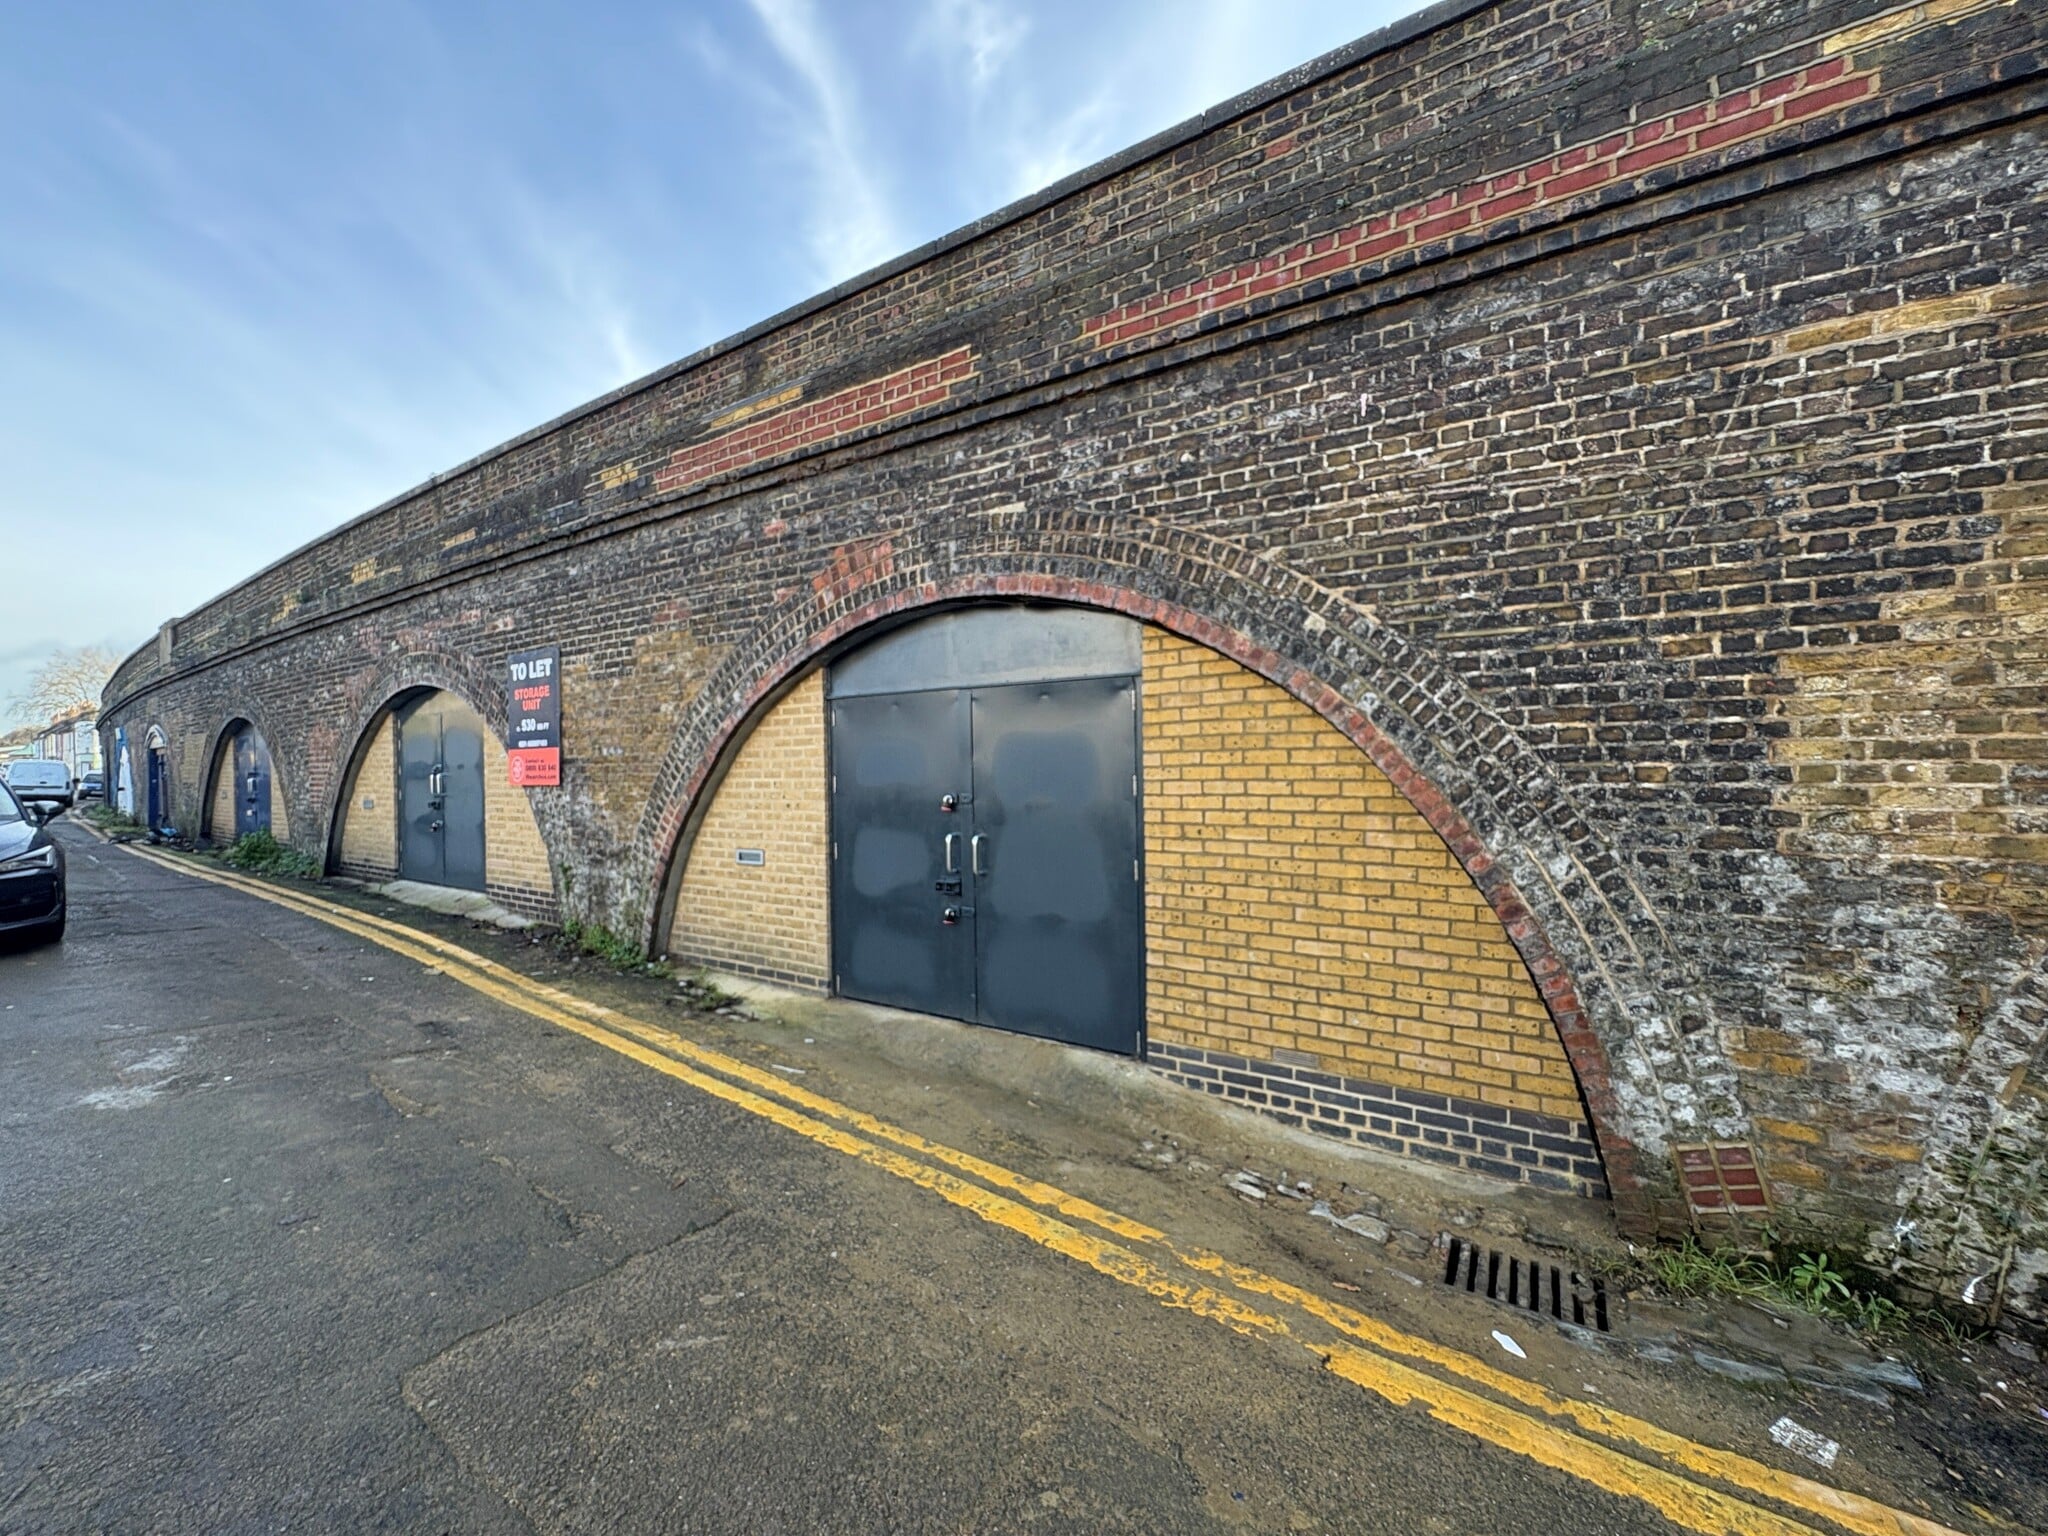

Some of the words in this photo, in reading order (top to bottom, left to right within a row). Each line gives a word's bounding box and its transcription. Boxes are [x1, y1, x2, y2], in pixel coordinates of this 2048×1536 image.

[510, 662, 527, 681] TO
[529, 658, 552, 679] LET
[514, 685, 550, 700] STORAGE
[522, 698, 541, 711] UNIT
